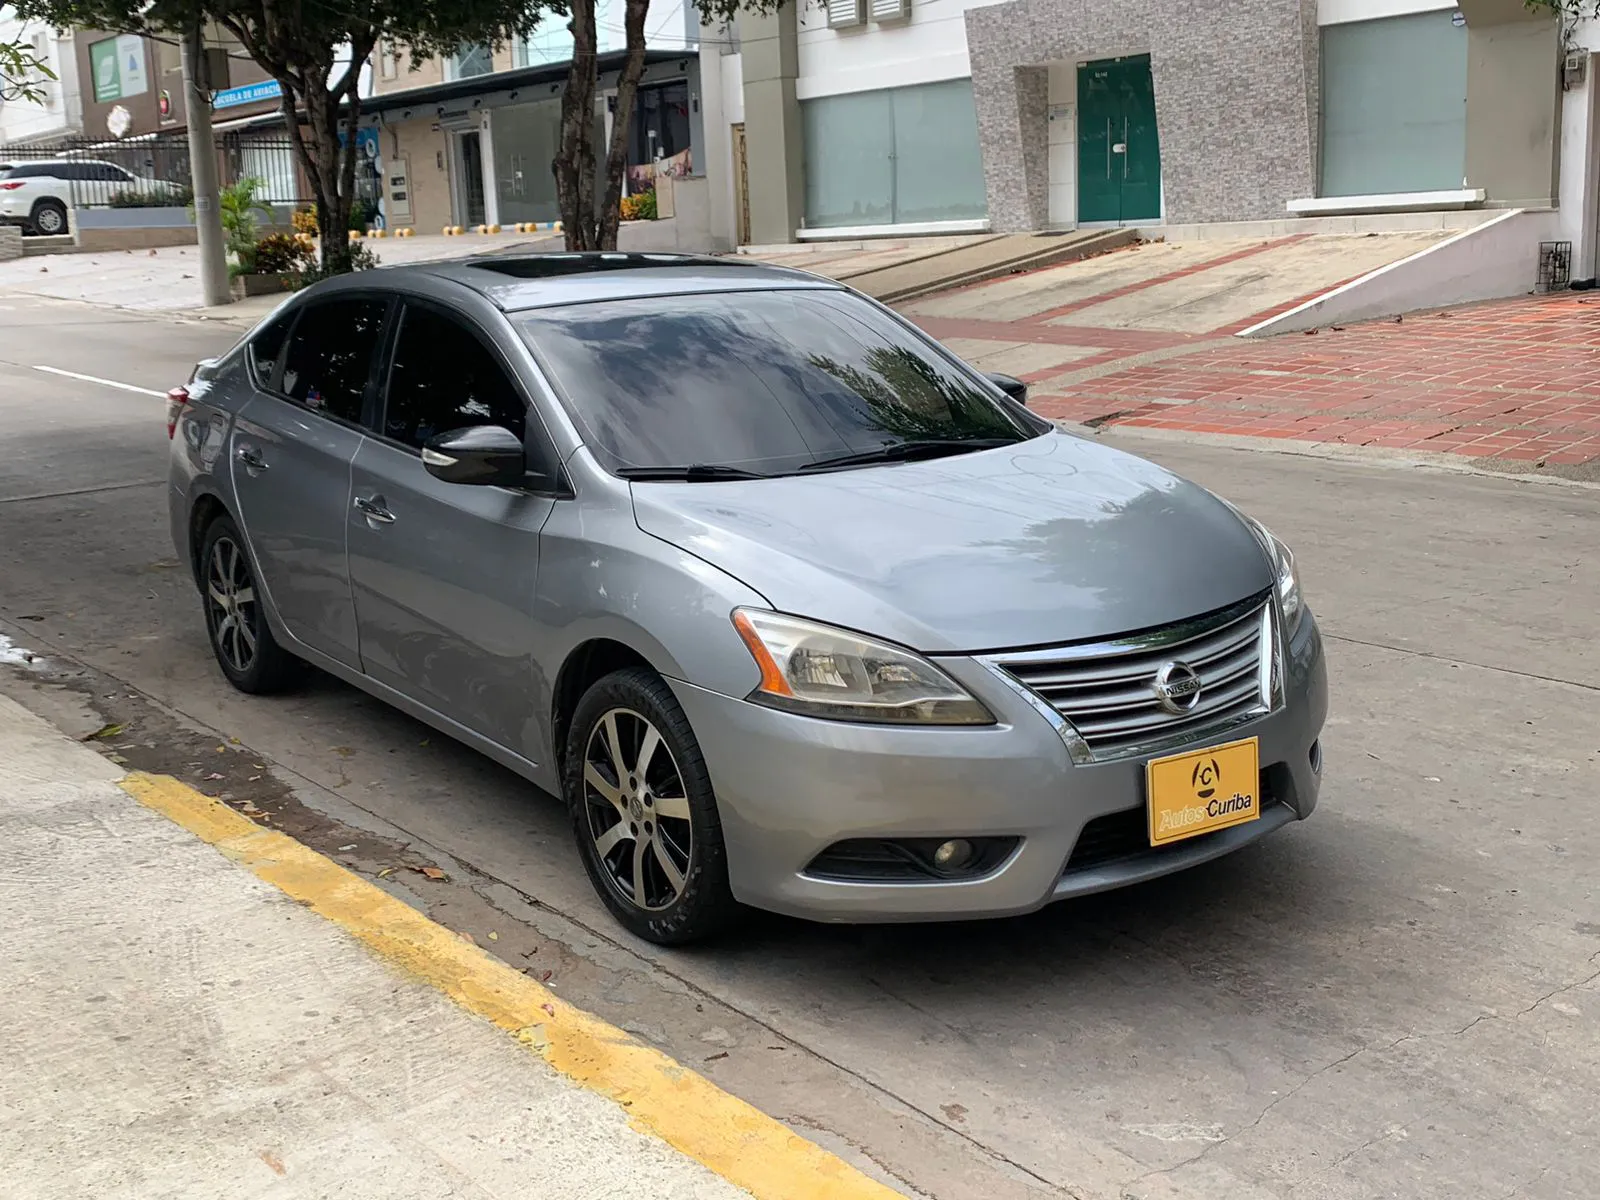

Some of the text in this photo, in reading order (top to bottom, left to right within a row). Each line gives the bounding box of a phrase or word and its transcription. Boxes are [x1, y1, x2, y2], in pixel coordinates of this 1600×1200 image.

[243, 89, 252, 99] DE
[1167, 681, 1200, 695] NISSAN
[1160, 793, 1252, 831] Autos Curiba
